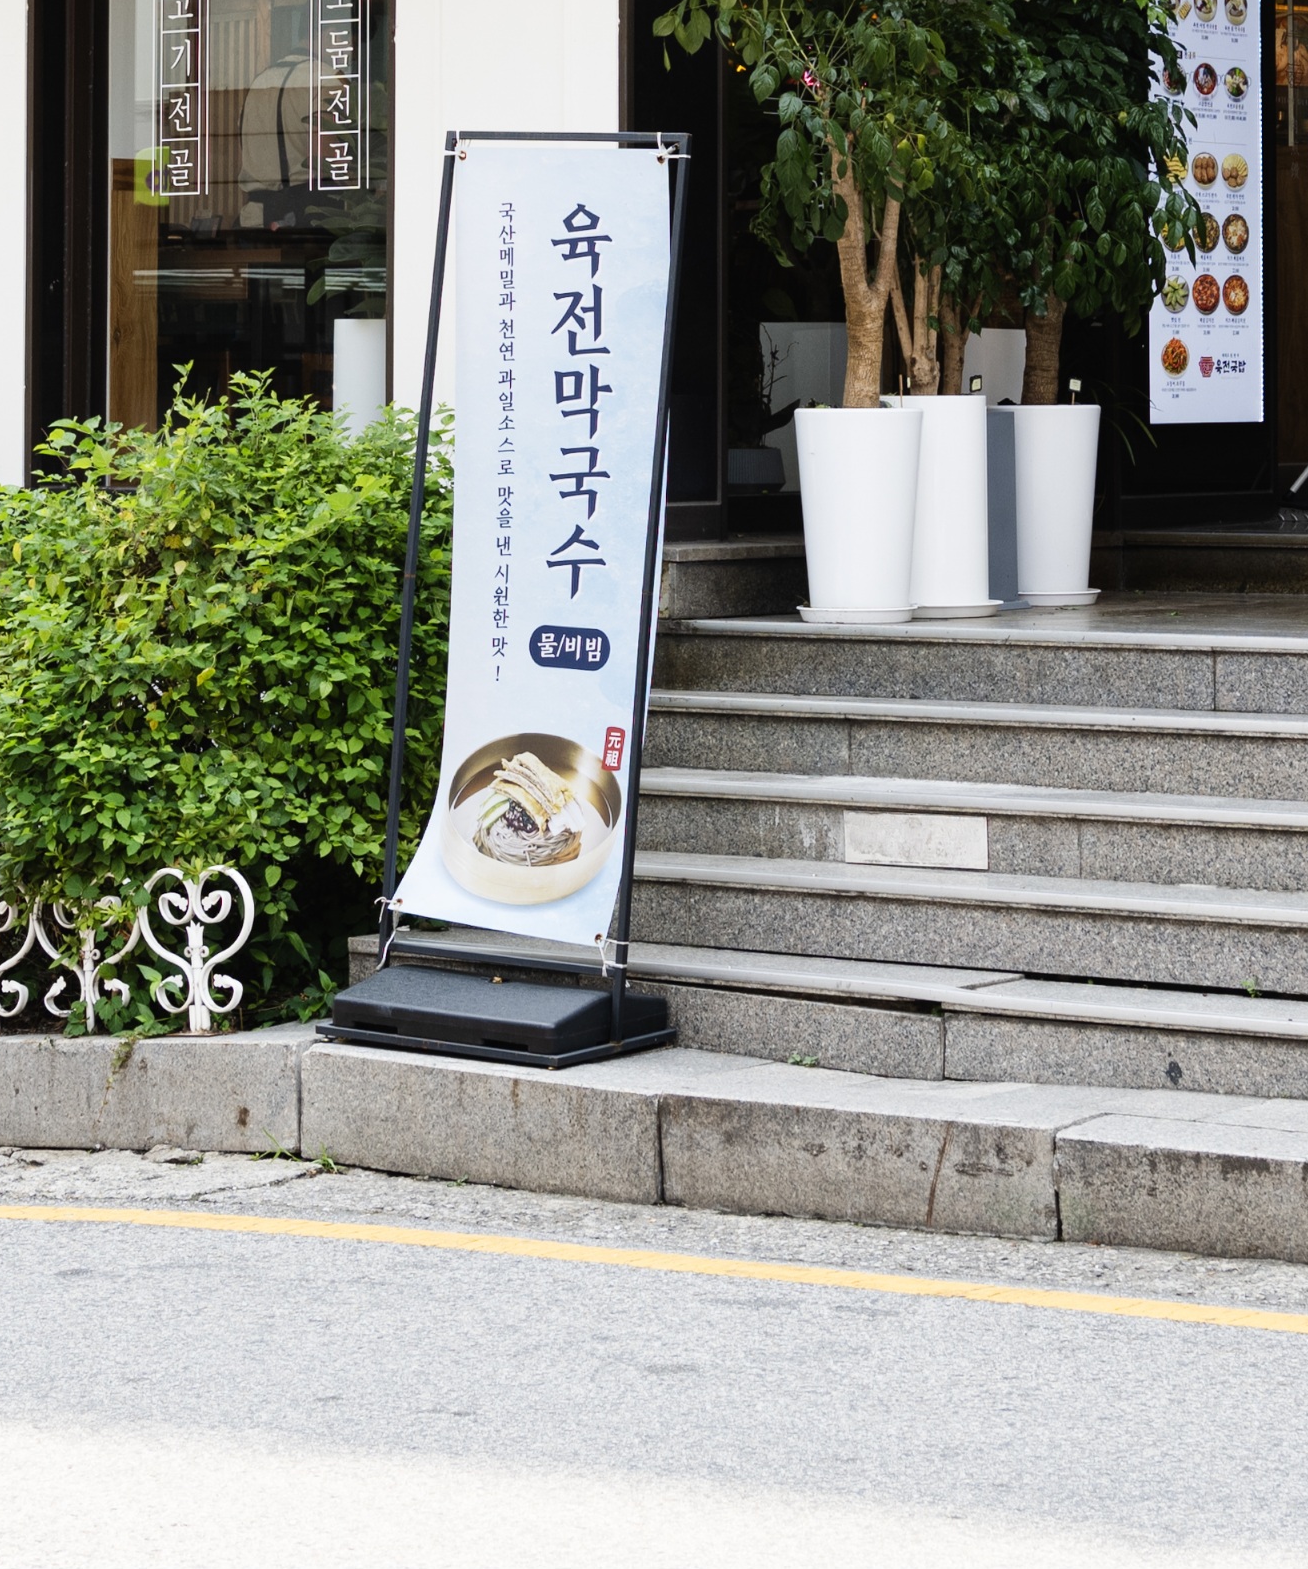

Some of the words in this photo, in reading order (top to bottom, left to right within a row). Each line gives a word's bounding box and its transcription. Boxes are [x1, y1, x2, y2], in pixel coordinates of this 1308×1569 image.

[497, 201, 516, 312] 국산메밀과
[497, 318, 516, 362] 천연
[545, 201, 614, 601] 육전막국수
[496, 486, 514, 529] 맛을
[495, 535, 513, 558] 낸
[492, 563, 510, 630] 시원한
[537, 630, 602, 663] 물/비빔
[604, 730, 623, 768] 元祖
